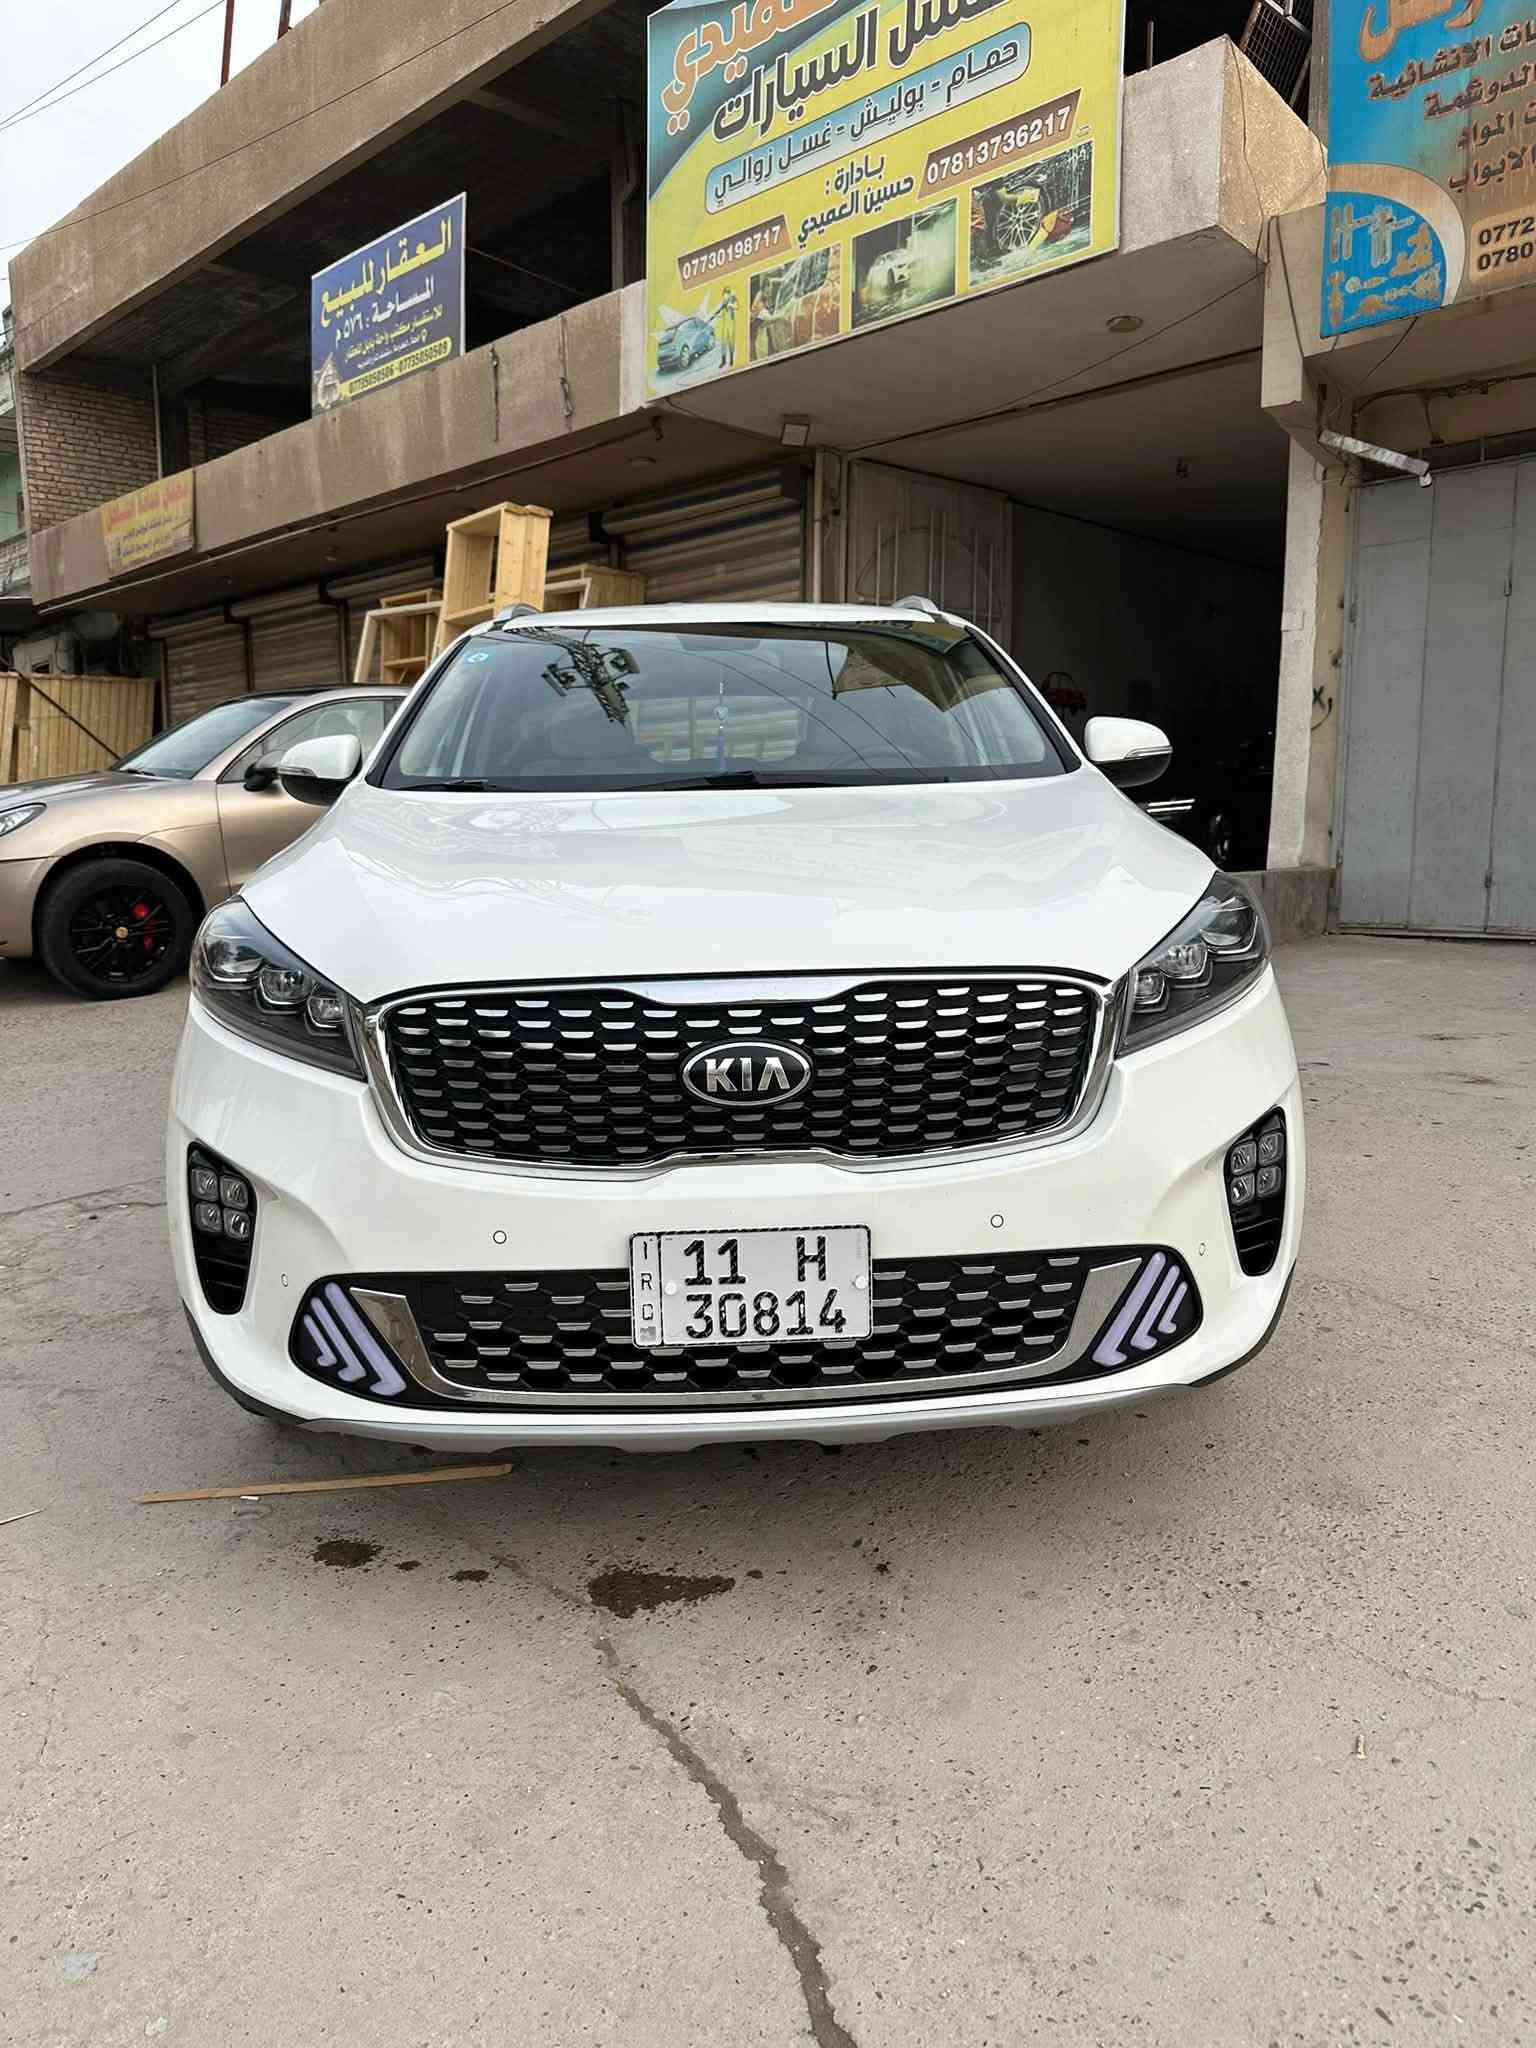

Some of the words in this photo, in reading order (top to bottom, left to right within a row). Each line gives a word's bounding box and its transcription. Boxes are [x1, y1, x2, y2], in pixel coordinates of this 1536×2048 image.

[889, 0, 1009, 68] سل
[713, 5, 880, 141] السيارات
[946, 40, 1019, 104] حمام
[851, 83, 924, 137] بوليش
[778, 121, 831, 170] غسل
[927, 106, 1071, 184] 07813736217
[714, 148, 773, 205] زوالي
[834, 155, 884, 194] بادارة
[863, 176, 914, 214] حسين
[798, 190, 859, 249] العميدي
[376, 216, 452, 295] العقار
[683, 225, 780, 280] 07730198717
[1478, 242, 1536, 270] 0780
[320, 259, 374, 328] للبيع
[372, 275, 434, 323] المساحة
[705, 1056, 791, 1092] KIA
[684, 1239, 746, 1286] 11
[797, 1235, 827, 1282] H
[686, 1288, 846, 1339] 30814
